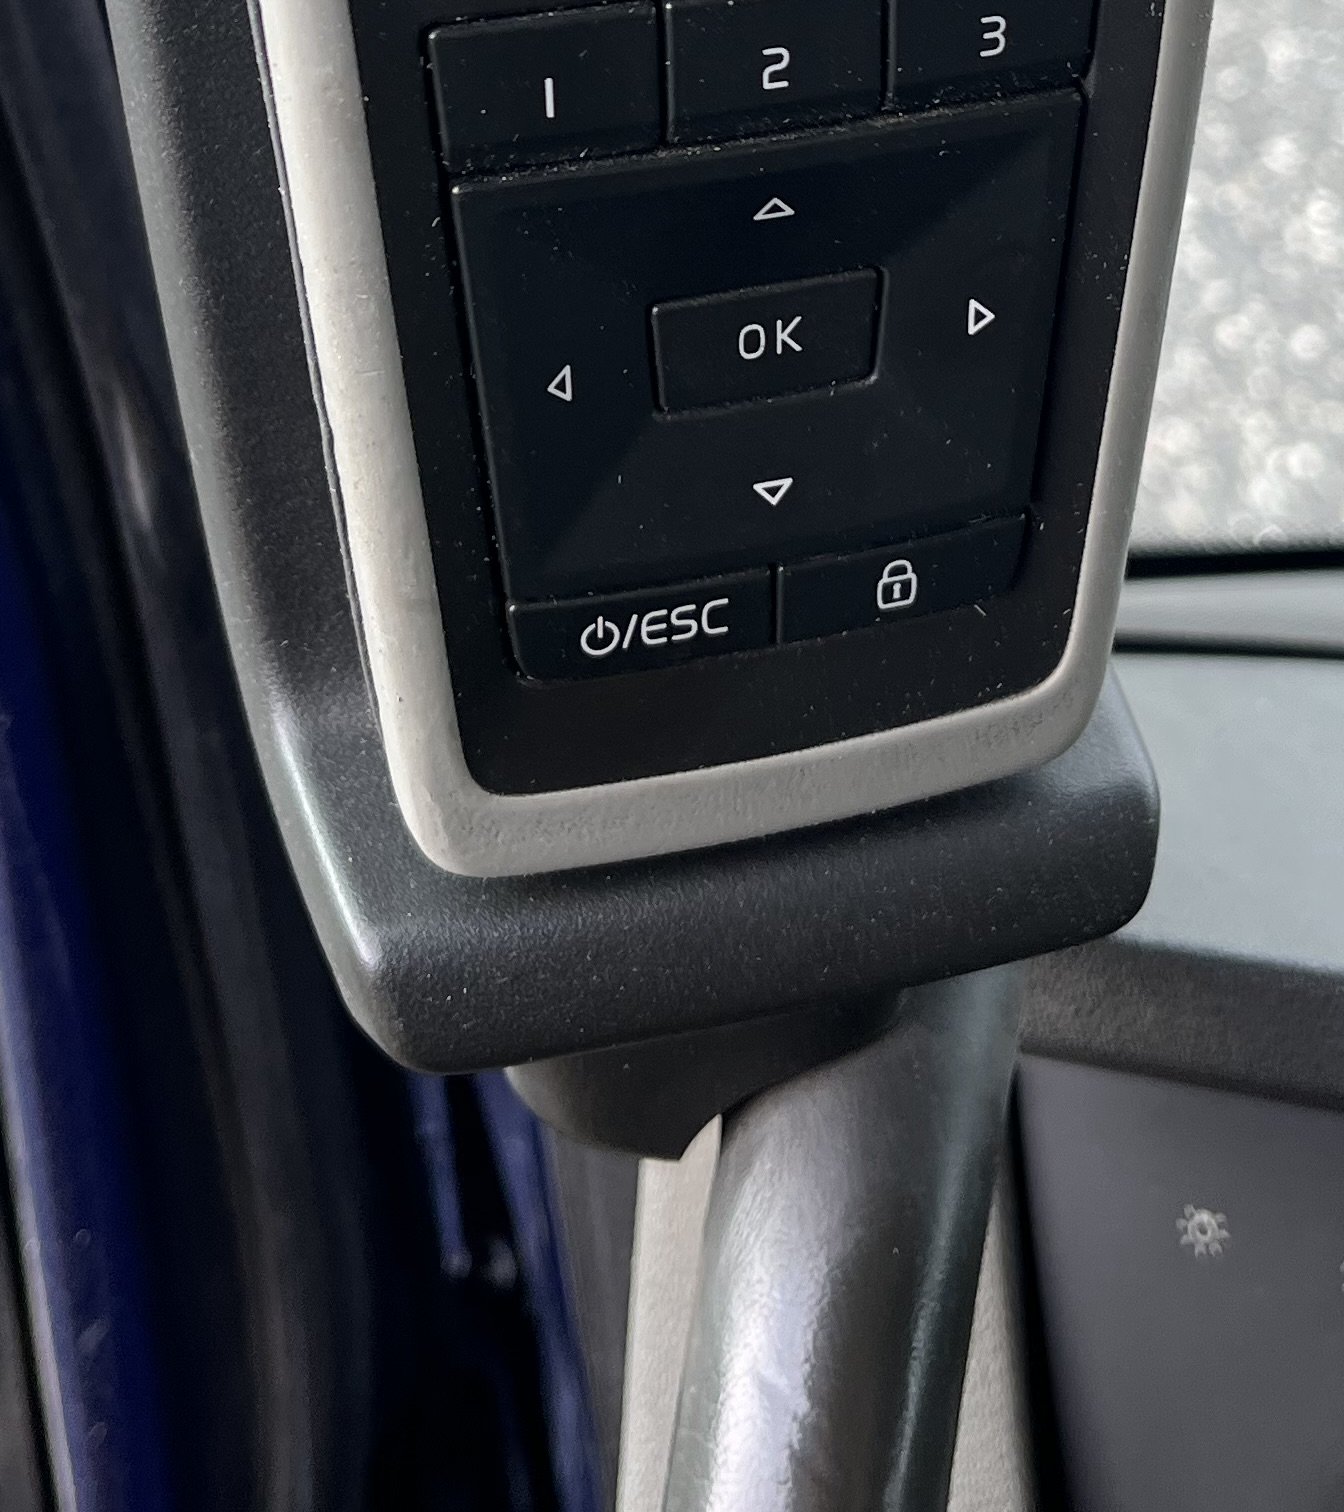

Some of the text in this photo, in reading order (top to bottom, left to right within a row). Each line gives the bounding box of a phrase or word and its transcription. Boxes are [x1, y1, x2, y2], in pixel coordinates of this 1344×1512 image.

[980, 15, 1006, 57] 3
[762, 47, 790, 89] 2
[543, 77, 556, 119] 1
[738, 316, 803, 359] OK
